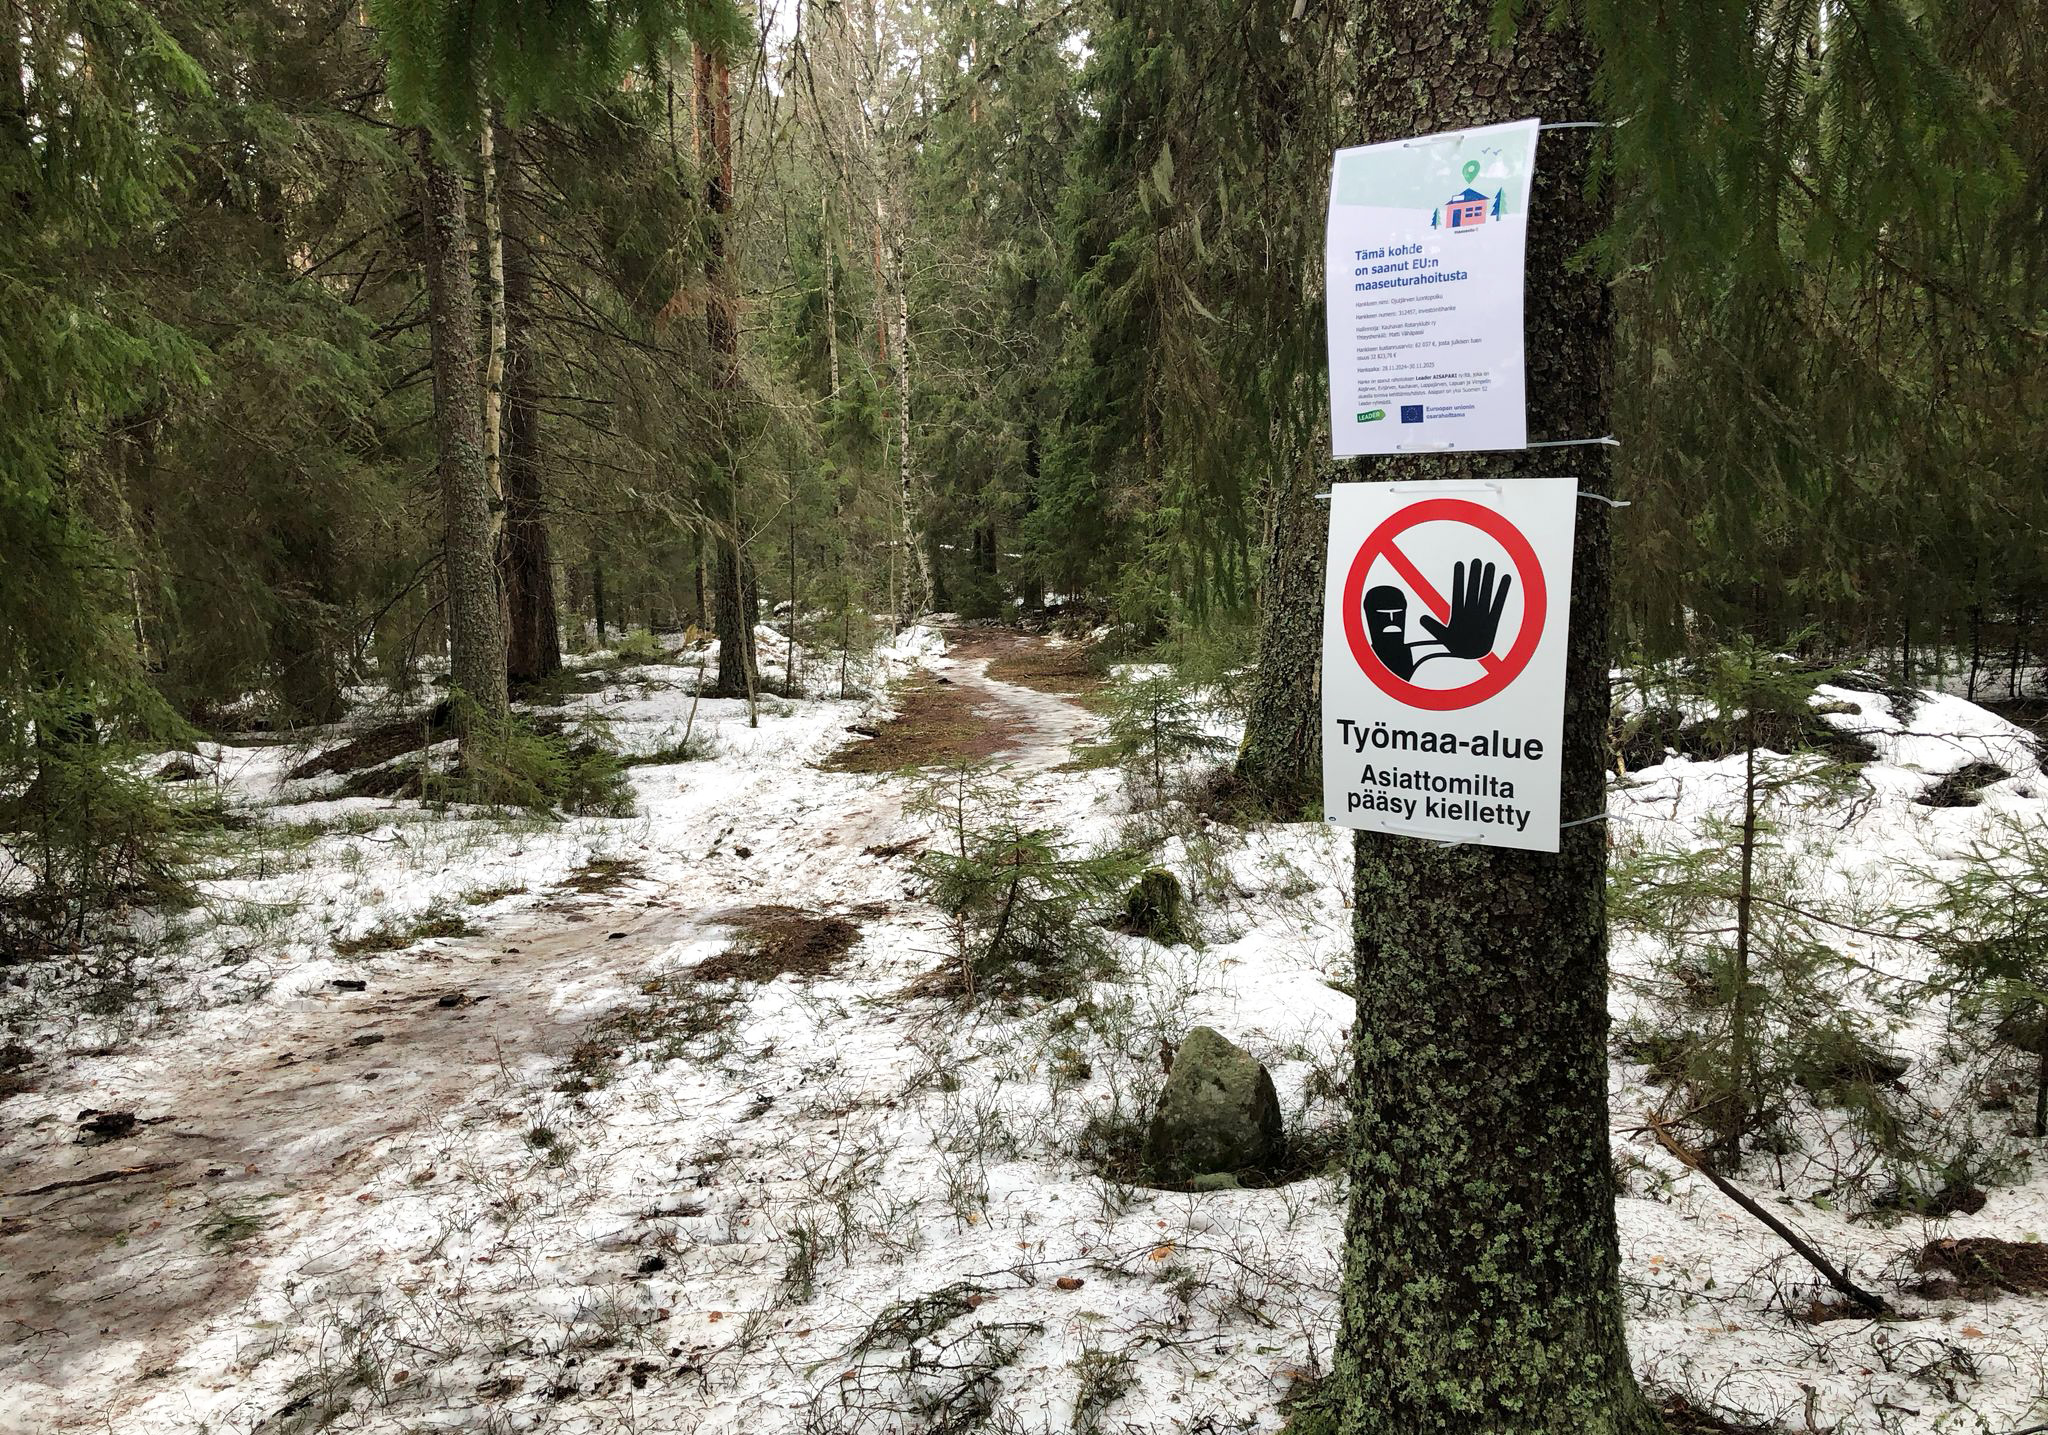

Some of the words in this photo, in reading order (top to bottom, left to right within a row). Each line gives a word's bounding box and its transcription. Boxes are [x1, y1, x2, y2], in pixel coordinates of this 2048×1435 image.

[1355, 247, 1385, 260] Tämä
[1388, 243, 1423, 257] kohde
[1355, 268, 1368, 276] on
[1371, 260, 1409, 274] saanut
[1412, 258, 1439, 269] EU:n
[1355, 270, 1468, 291] maaseuturahoitusta
[1358, 411, 1380, 421] LEADER
[1337, 718, 1544, 760] Työmaa-alue
[1361, 764, 1514, 798] Asiattomilta
[1348, 789, 1417, 820] pääsy
[1425, 796, 1531, 831] kielletty
